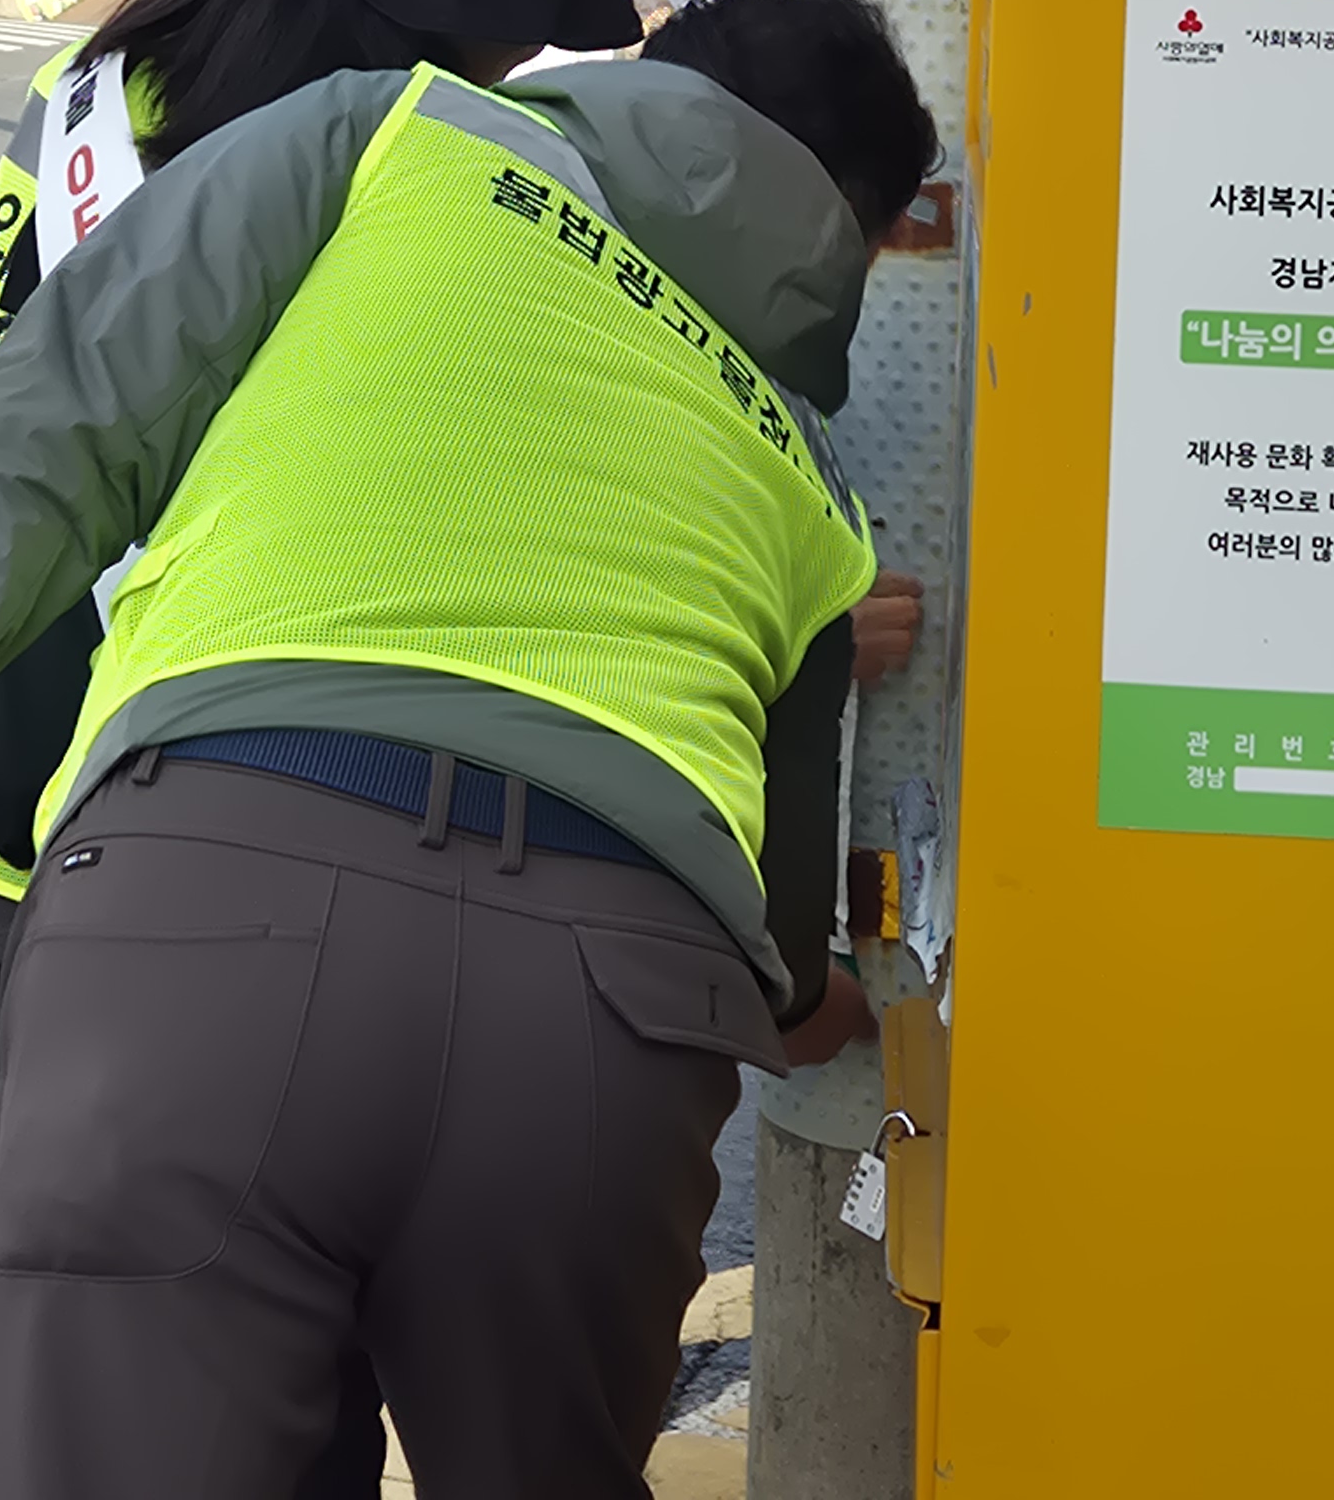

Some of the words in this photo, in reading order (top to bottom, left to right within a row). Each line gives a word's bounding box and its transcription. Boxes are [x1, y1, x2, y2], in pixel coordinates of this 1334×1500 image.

[1187, 440, 1257, 469] 재사용
[1266, 444, 1313, 471] 문화
[1225, 487, 1319, 514] 목적으로
[1208, 532, 1301, 560] 여러분의
[1186, 765, 1225, 789] 경남
